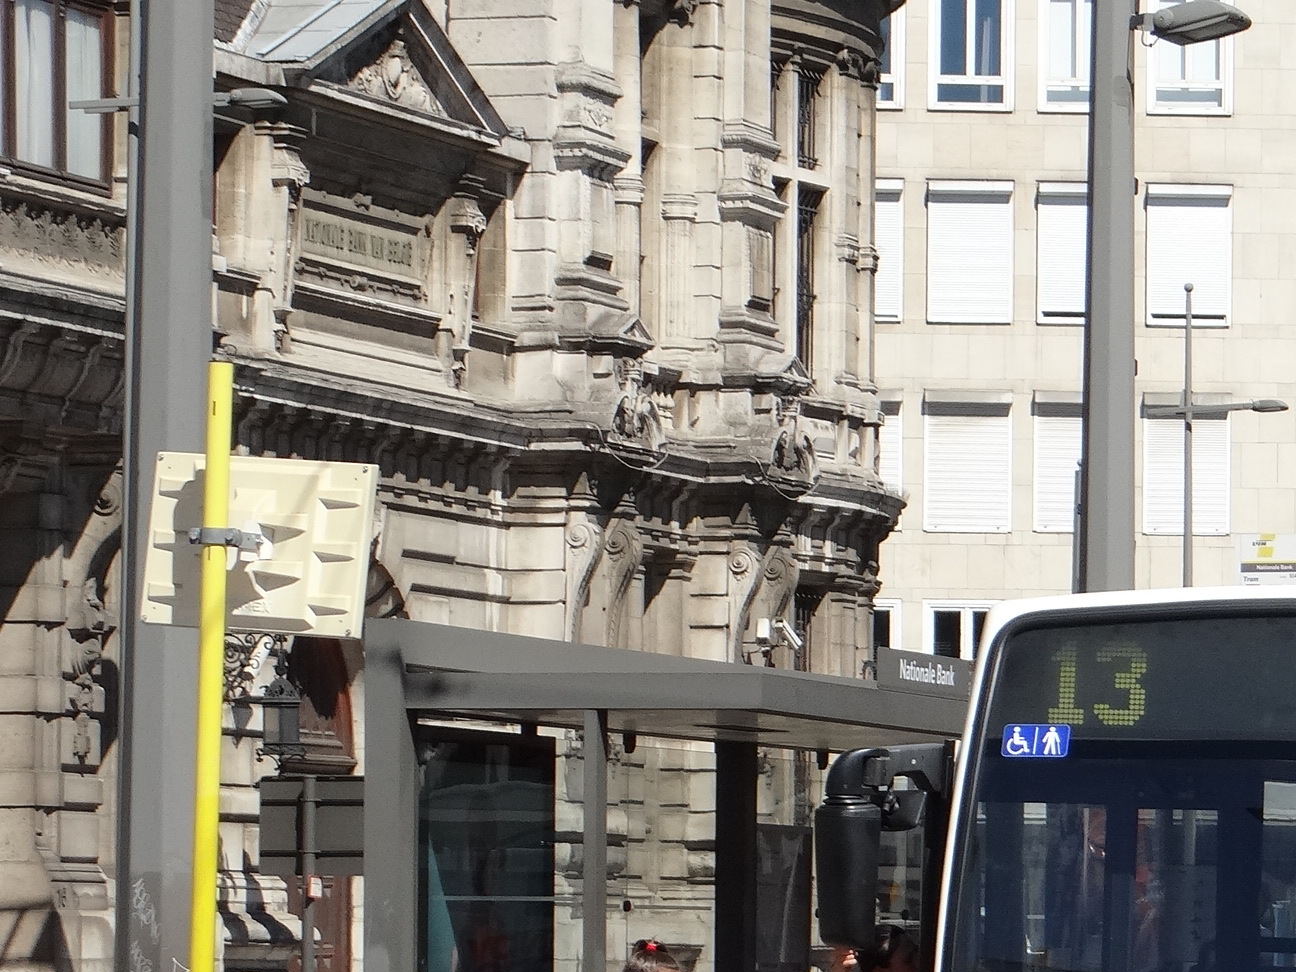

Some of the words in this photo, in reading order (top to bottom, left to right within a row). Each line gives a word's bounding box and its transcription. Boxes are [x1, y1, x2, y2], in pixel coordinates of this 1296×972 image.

[900, 658, 936, 684] Nationale
[936, 663, 955, 687] Bank
[1047, 641, 1147, 725] 13
